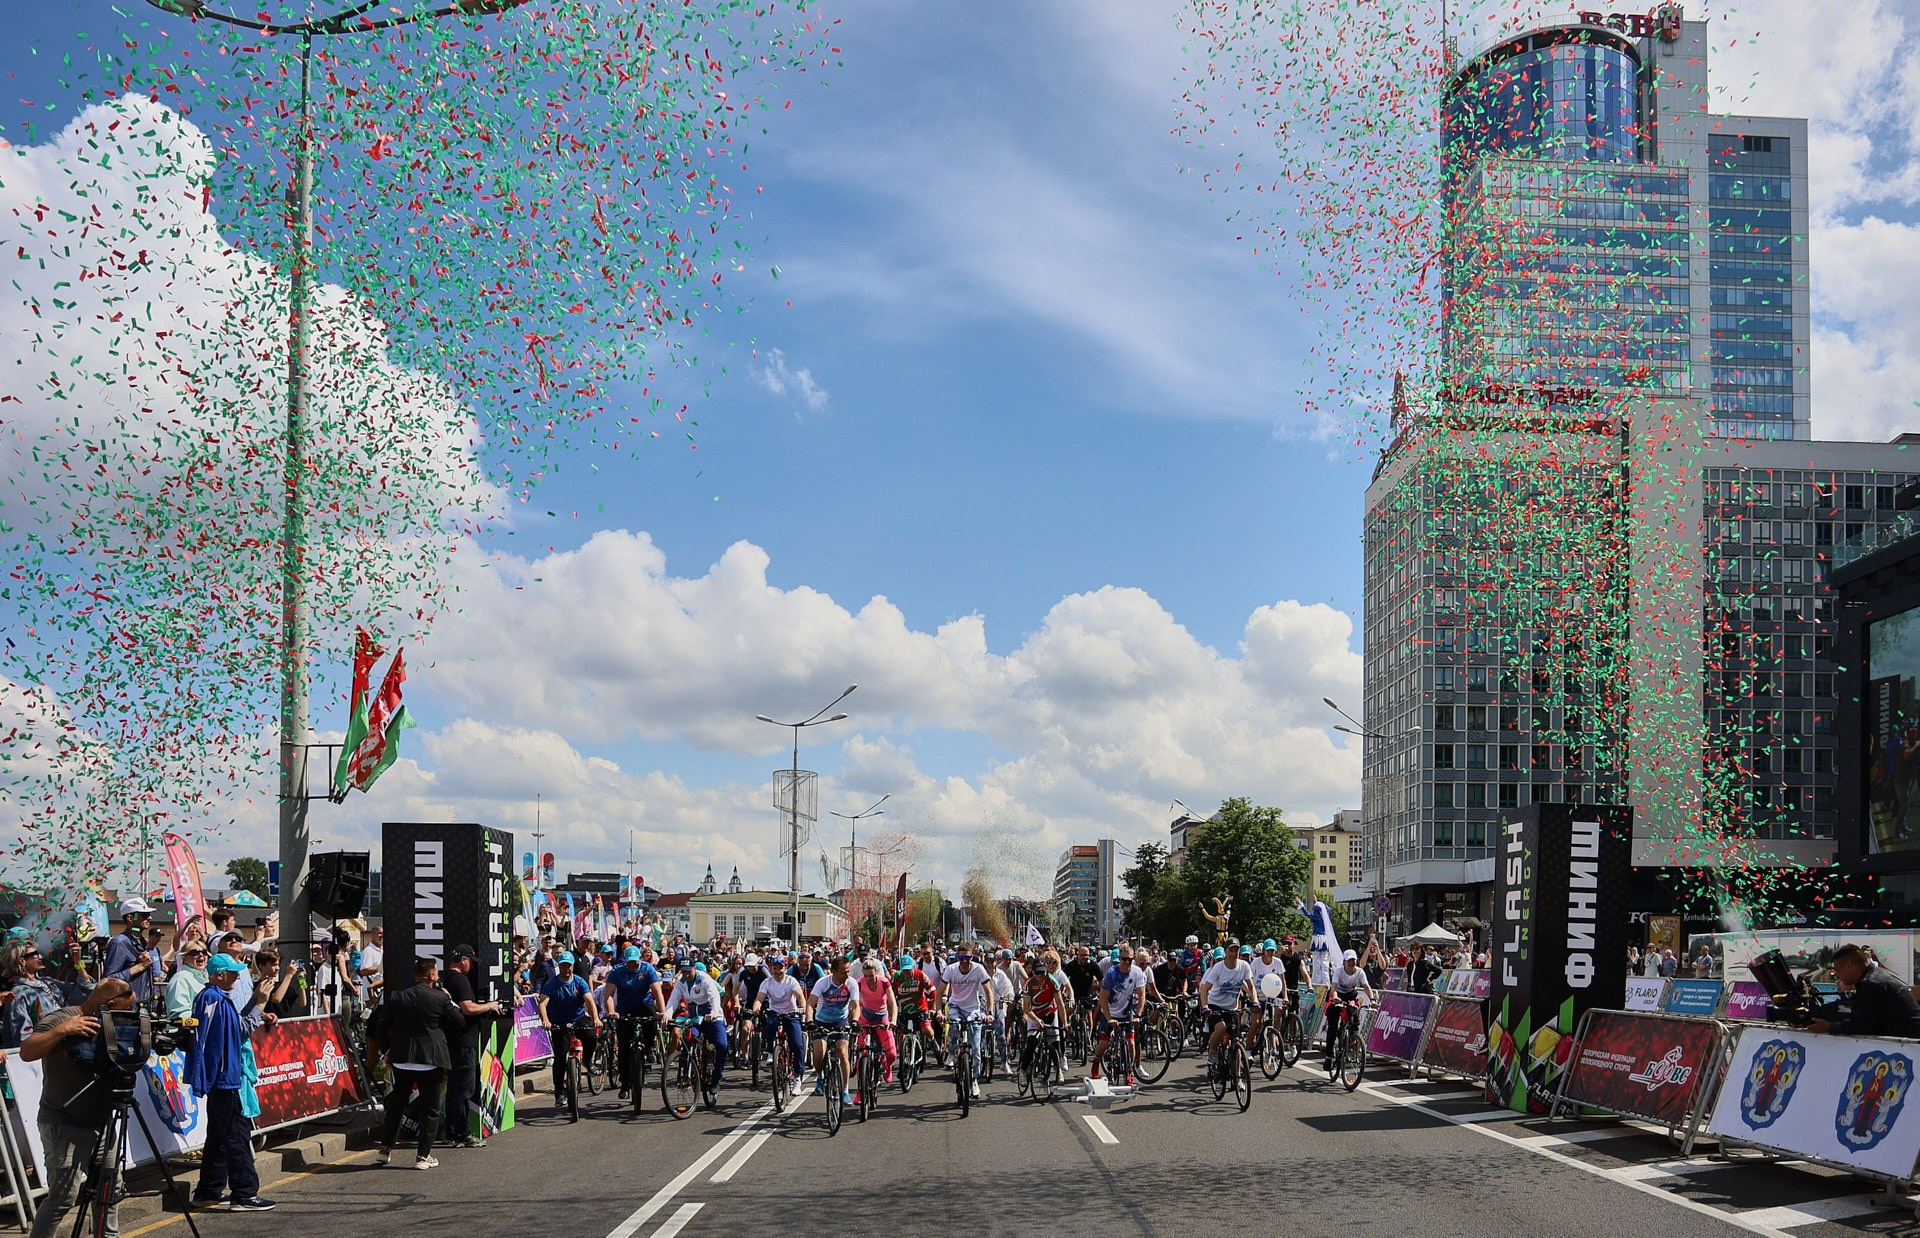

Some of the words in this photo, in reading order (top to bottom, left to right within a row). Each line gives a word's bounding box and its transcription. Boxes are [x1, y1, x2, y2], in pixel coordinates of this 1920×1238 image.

[414, 841, 444, 971] ИНИШ
[1503, 822, 1523, 987] FLASH
[1521, 848, 1532, 960] ENERGY
[1564, 821, 1600, 988] ФИНИШ
[1634, 987, 1658, 998] FLARIO
